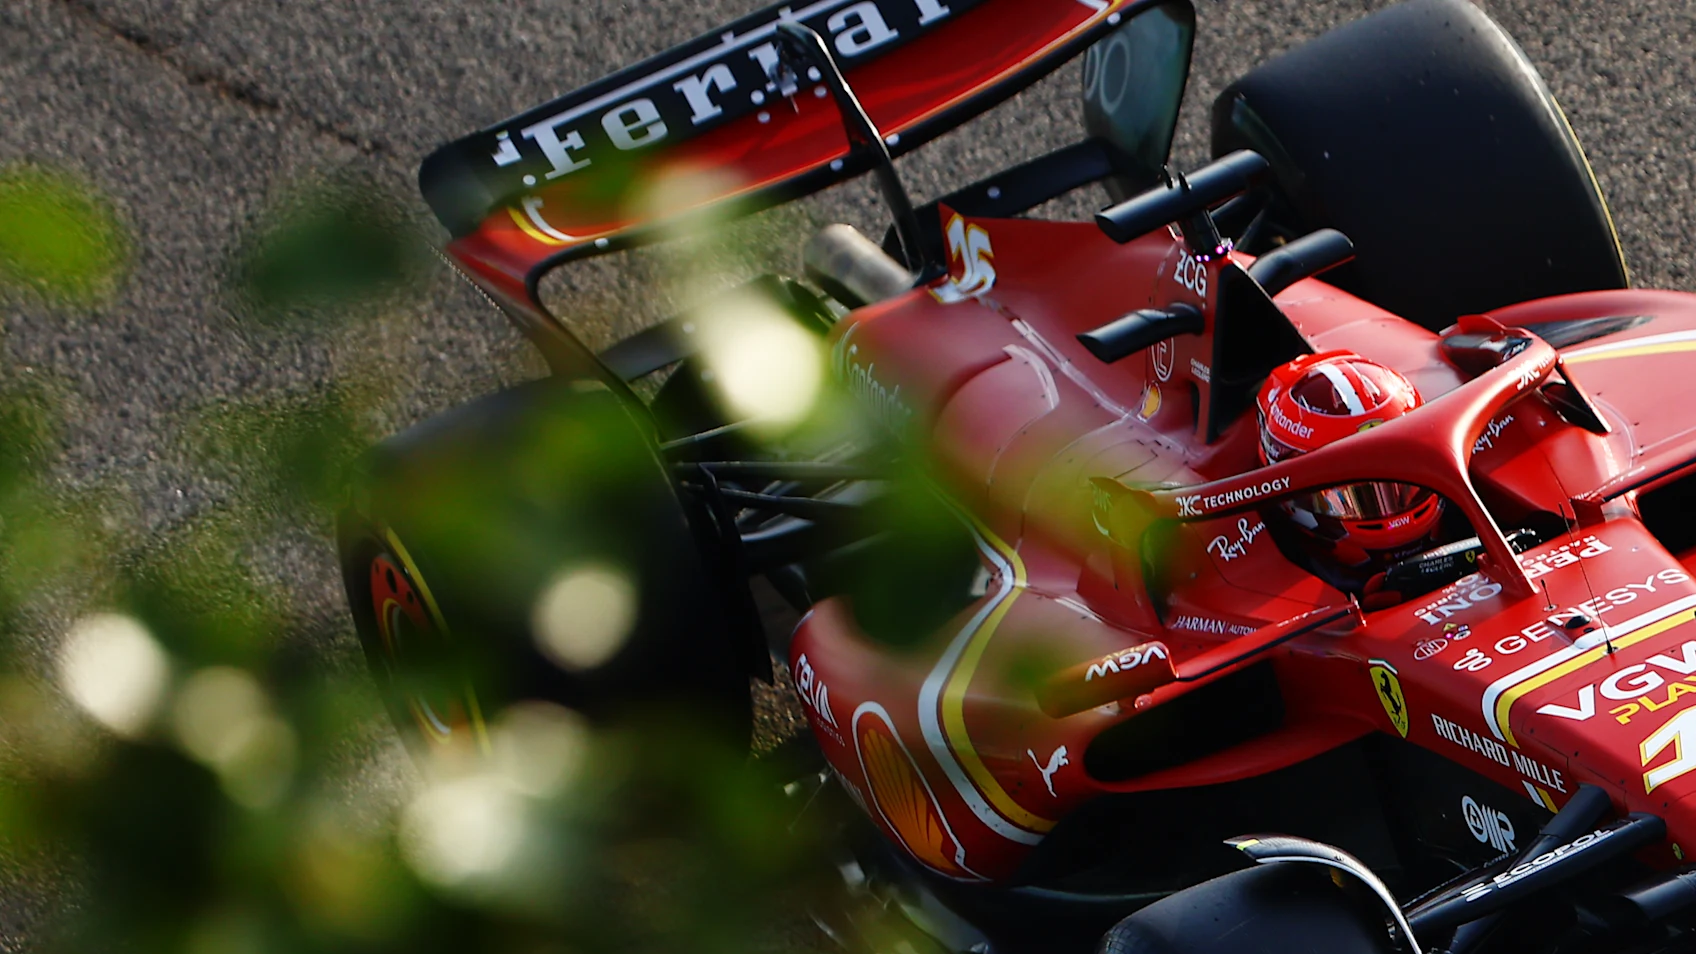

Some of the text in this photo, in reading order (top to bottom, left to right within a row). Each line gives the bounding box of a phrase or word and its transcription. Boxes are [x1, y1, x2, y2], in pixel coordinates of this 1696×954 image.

[1203, 476, 1291, 509] TECHNOLOGY
[1493, 568, 1691, 656] GENESYS
[1430, 712, 1567, 794] RICHARD MILLE
[1492, 828, 1613, 886] ECOPOL
